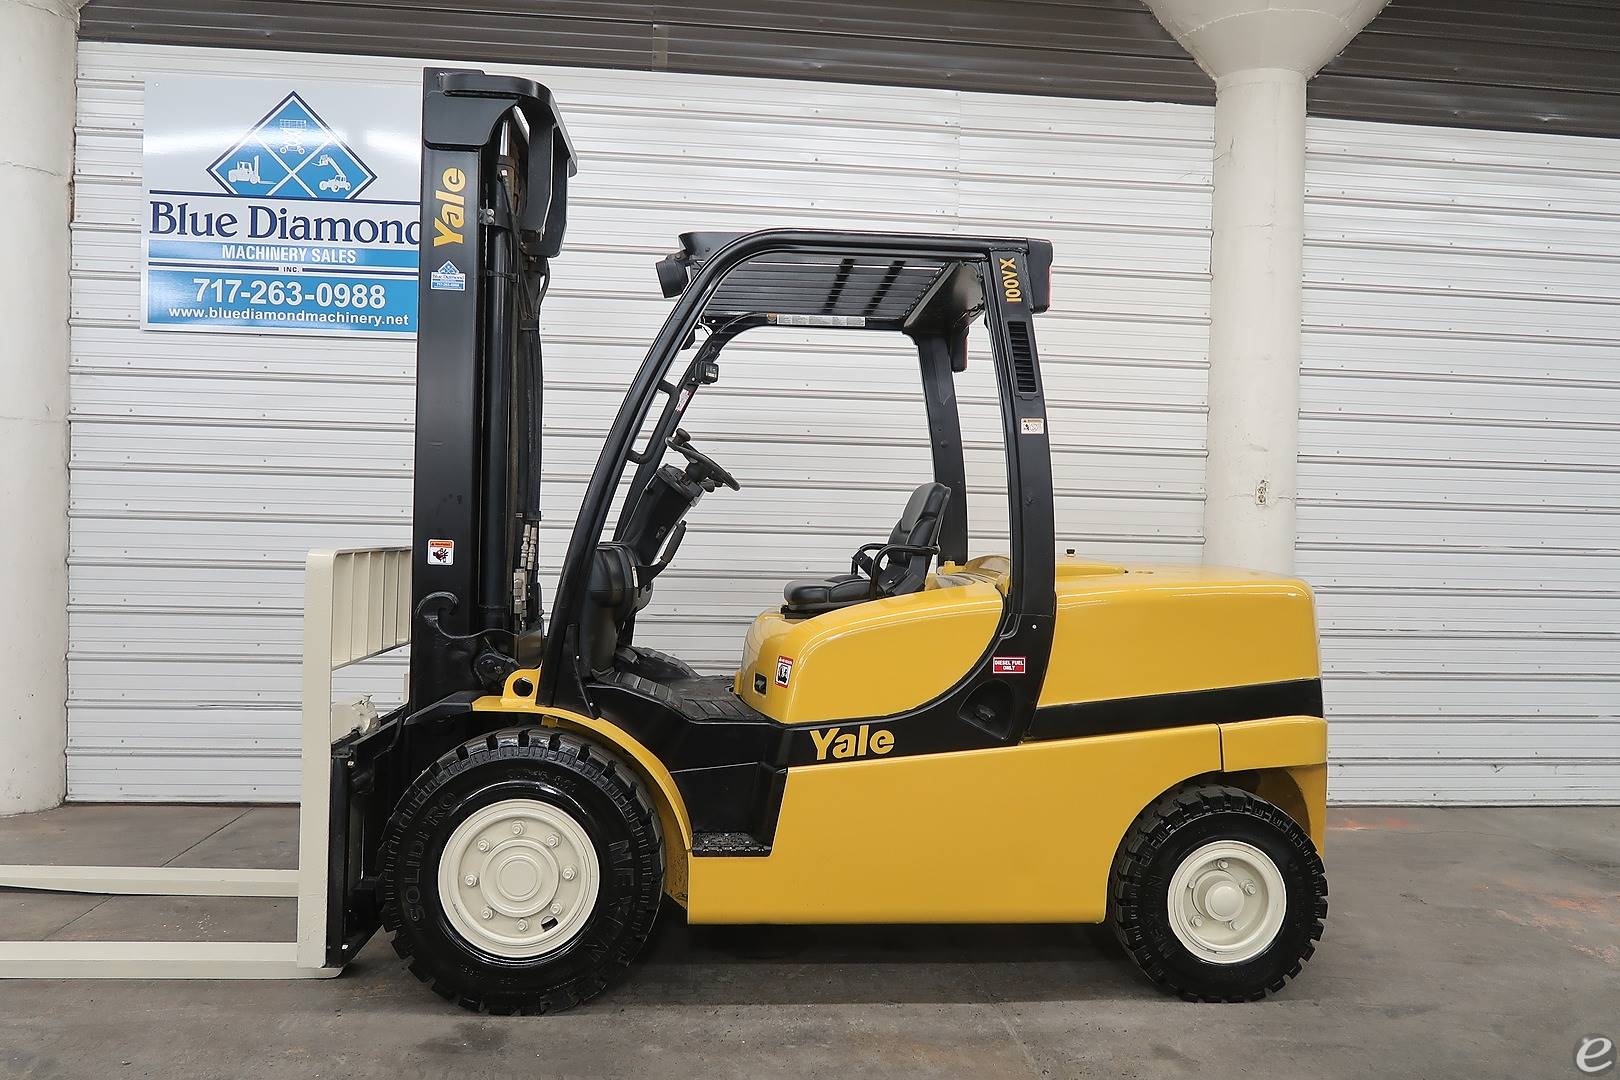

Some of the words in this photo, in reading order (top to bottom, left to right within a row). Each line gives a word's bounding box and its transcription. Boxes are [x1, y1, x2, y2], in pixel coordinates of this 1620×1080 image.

[149, 201, 238, 238] Blue
[434, 167, 466, 247] Yale
[222, 244, 308, 262] MACHINERY
[311, 248, 357, 264] SALES
[192, 278, 386, 309] 717-263-0988
[999, 257, 1022, 302] 100VX
[169, 307, 409, 326] www.bluediamondmachinery.net
[809, 724, 895, 761] Yale
